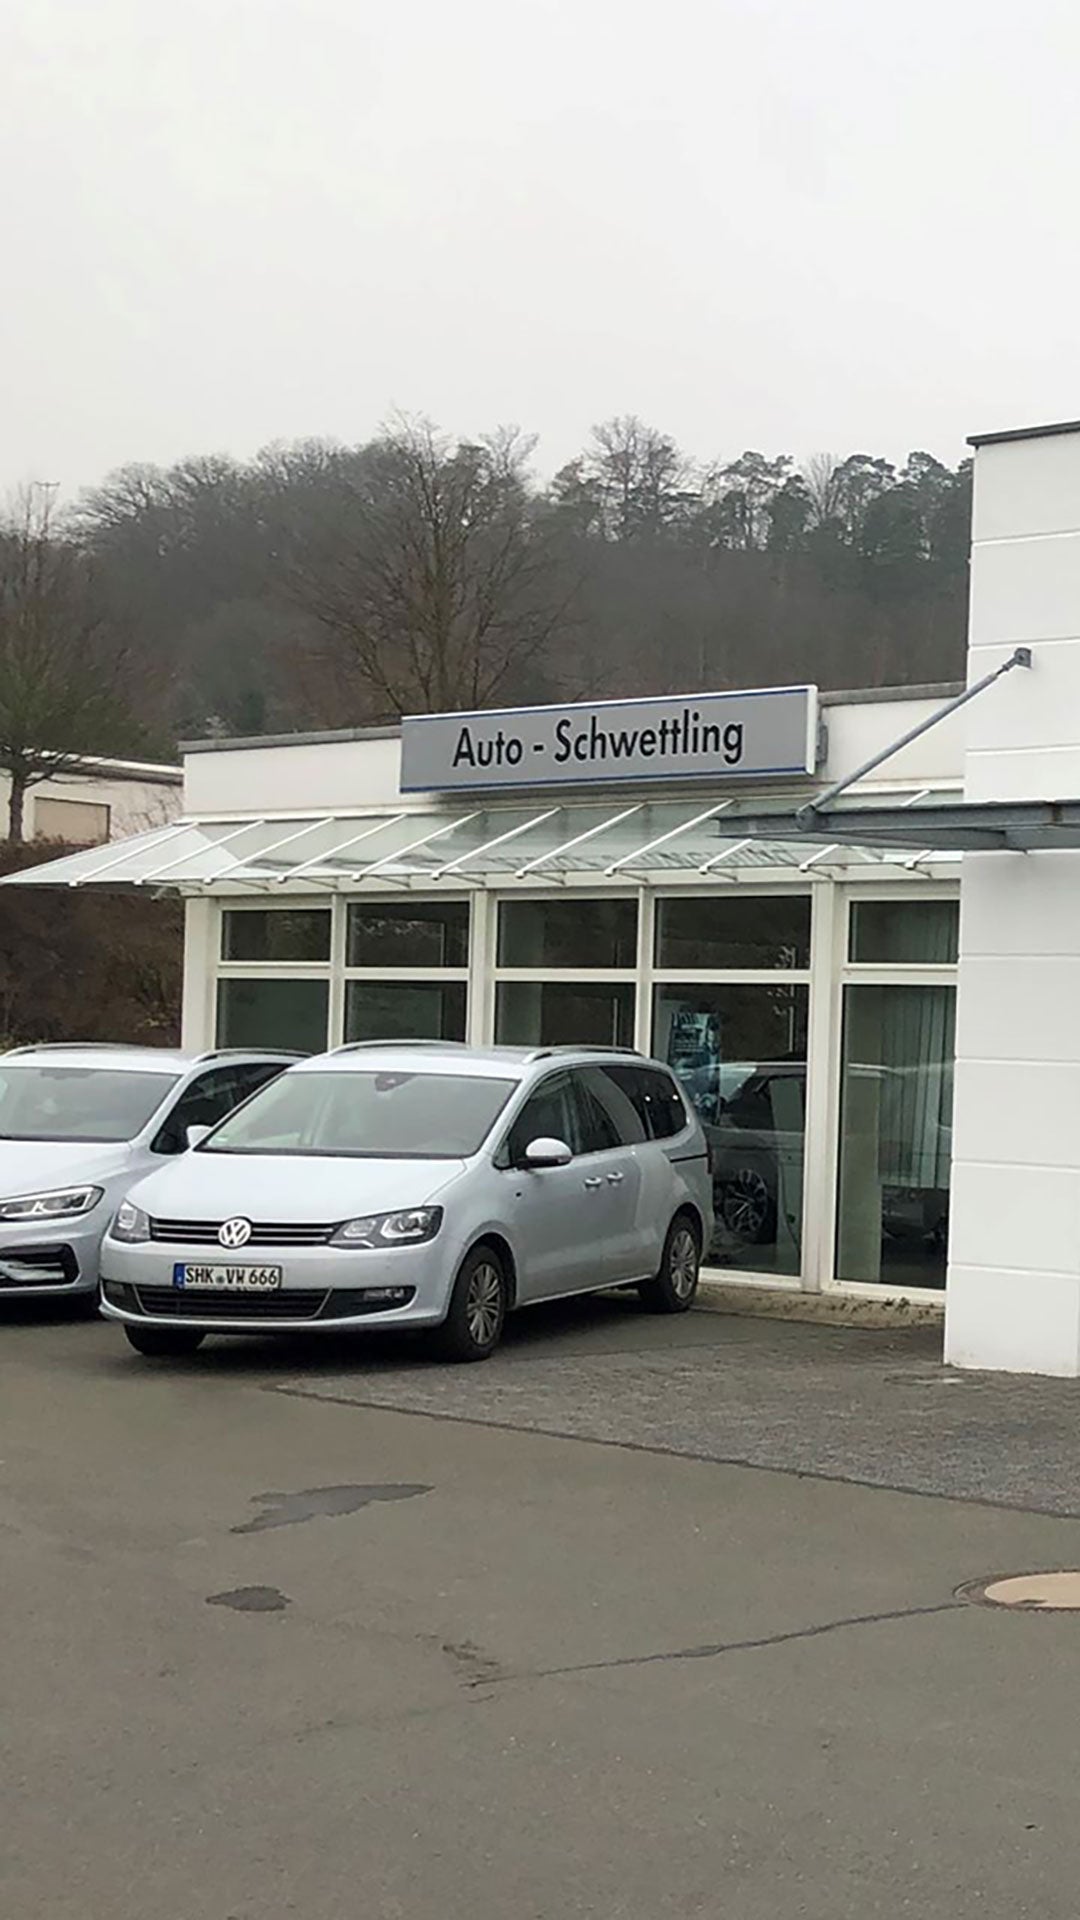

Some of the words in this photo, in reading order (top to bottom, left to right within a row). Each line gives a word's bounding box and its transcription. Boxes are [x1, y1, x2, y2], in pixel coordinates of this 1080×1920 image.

[452, 727, 522, 768] Auto
[554, 709, 743, 764] Schwettling
[218, 1218, 251, 1248] VW
[186, 1267, 214, 1283] SHK
[226, 1268, 245, 1284] VW
[249, 1269, 277, 1285] 666
